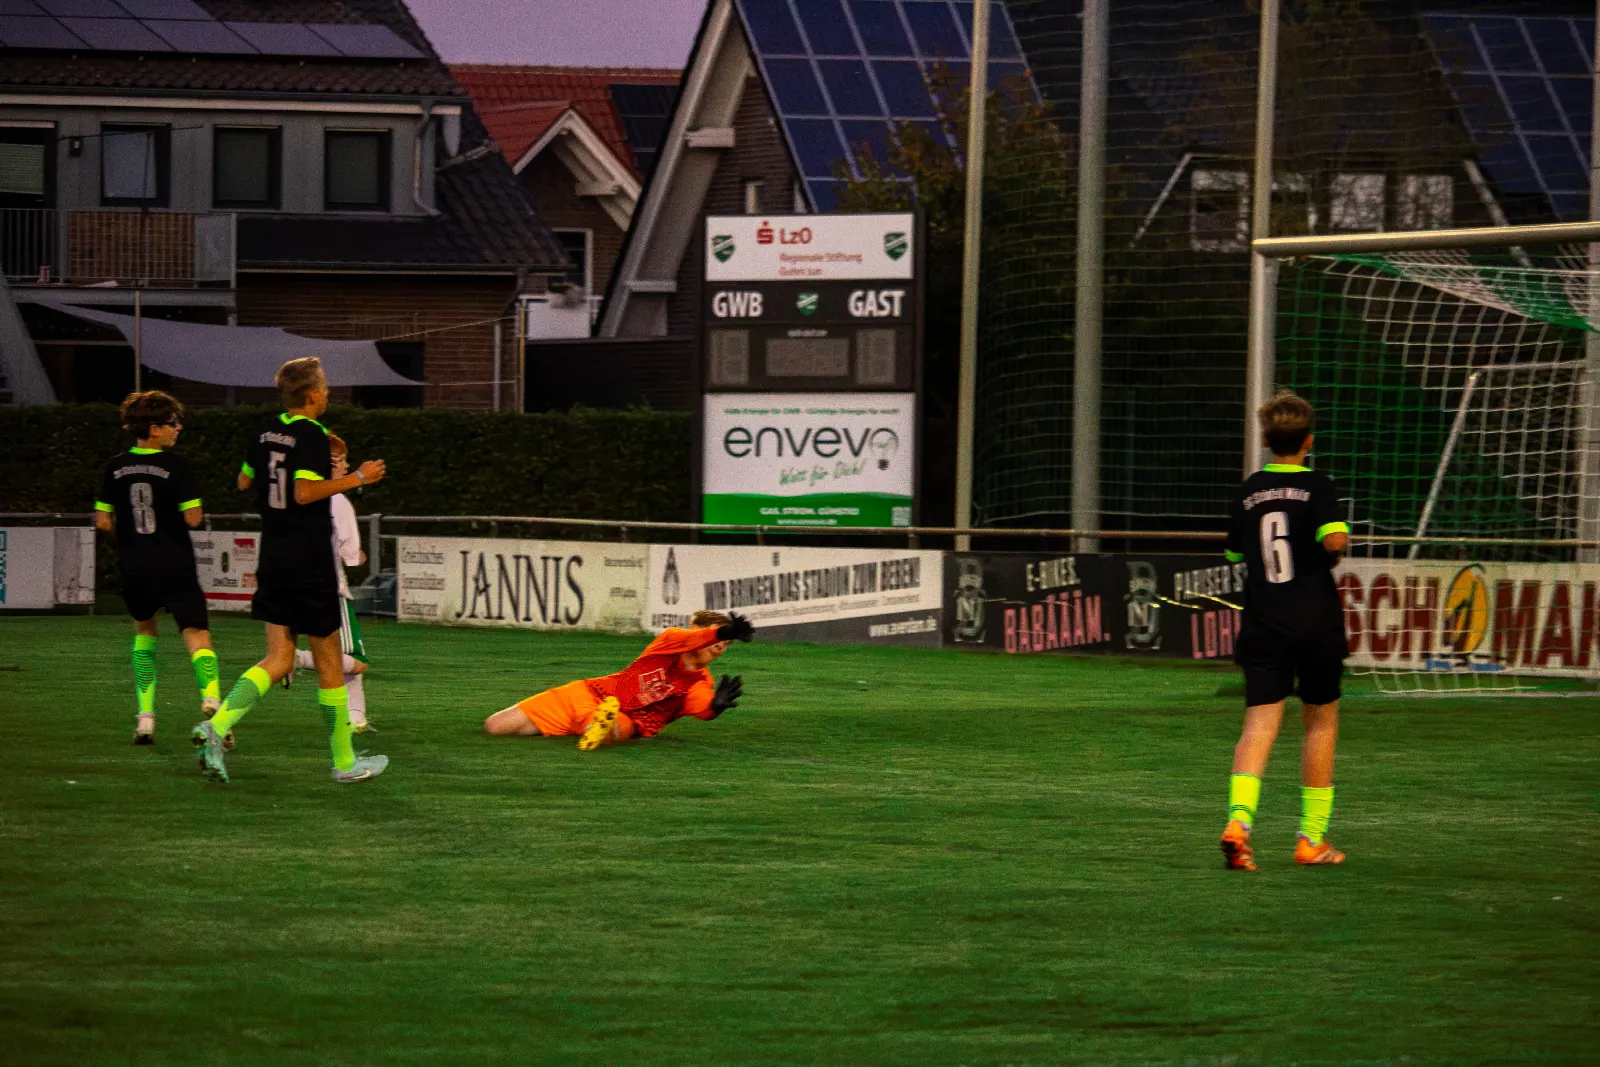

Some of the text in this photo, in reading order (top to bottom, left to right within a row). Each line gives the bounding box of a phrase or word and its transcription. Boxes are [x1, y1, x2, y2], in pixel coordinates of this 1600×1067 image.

[712, 290, 764, 318] GWB
[848, 290, 905, 318] GAST
[723, 427, 899, 458] envevo
[268, 451, 287, 509] 5
[129, 482, 157, 534] 8
[1259, 511, 1295, 583] 6
[455, 550, 584, 625] JANNIS
